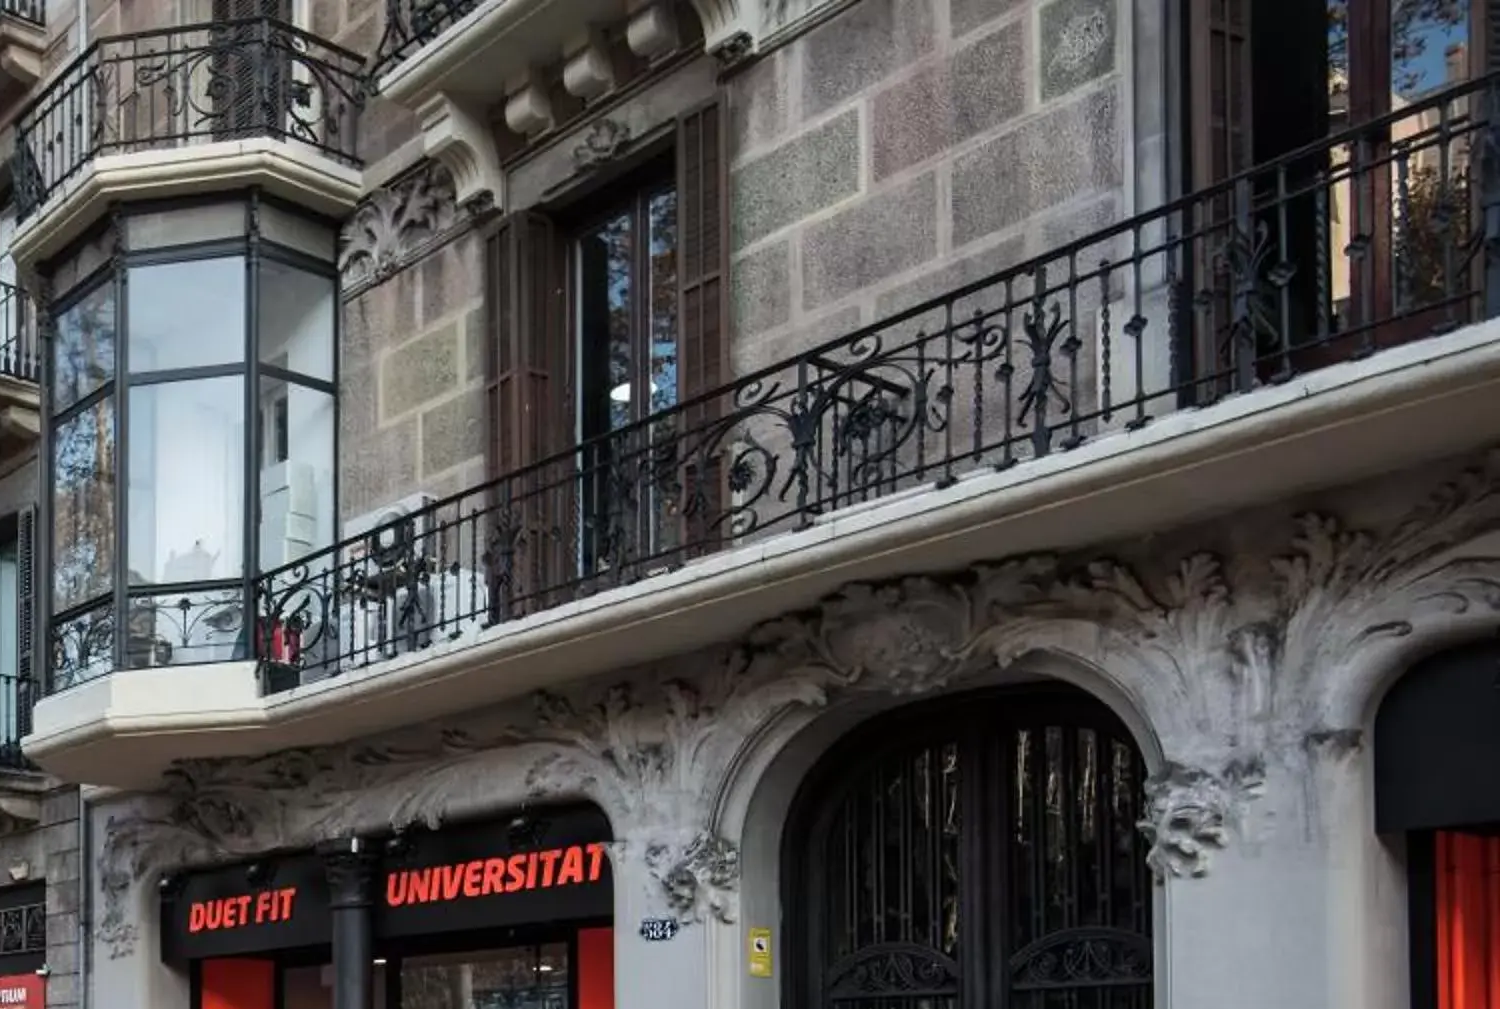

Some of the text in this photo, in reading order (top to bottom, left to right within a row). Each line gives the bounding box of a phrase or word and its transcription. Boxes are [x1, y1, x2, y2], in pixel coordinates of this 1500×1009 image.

[386, 842, 606, 906] UNIVERSITAT
[188, 887, 297, 933] DUET FIT
